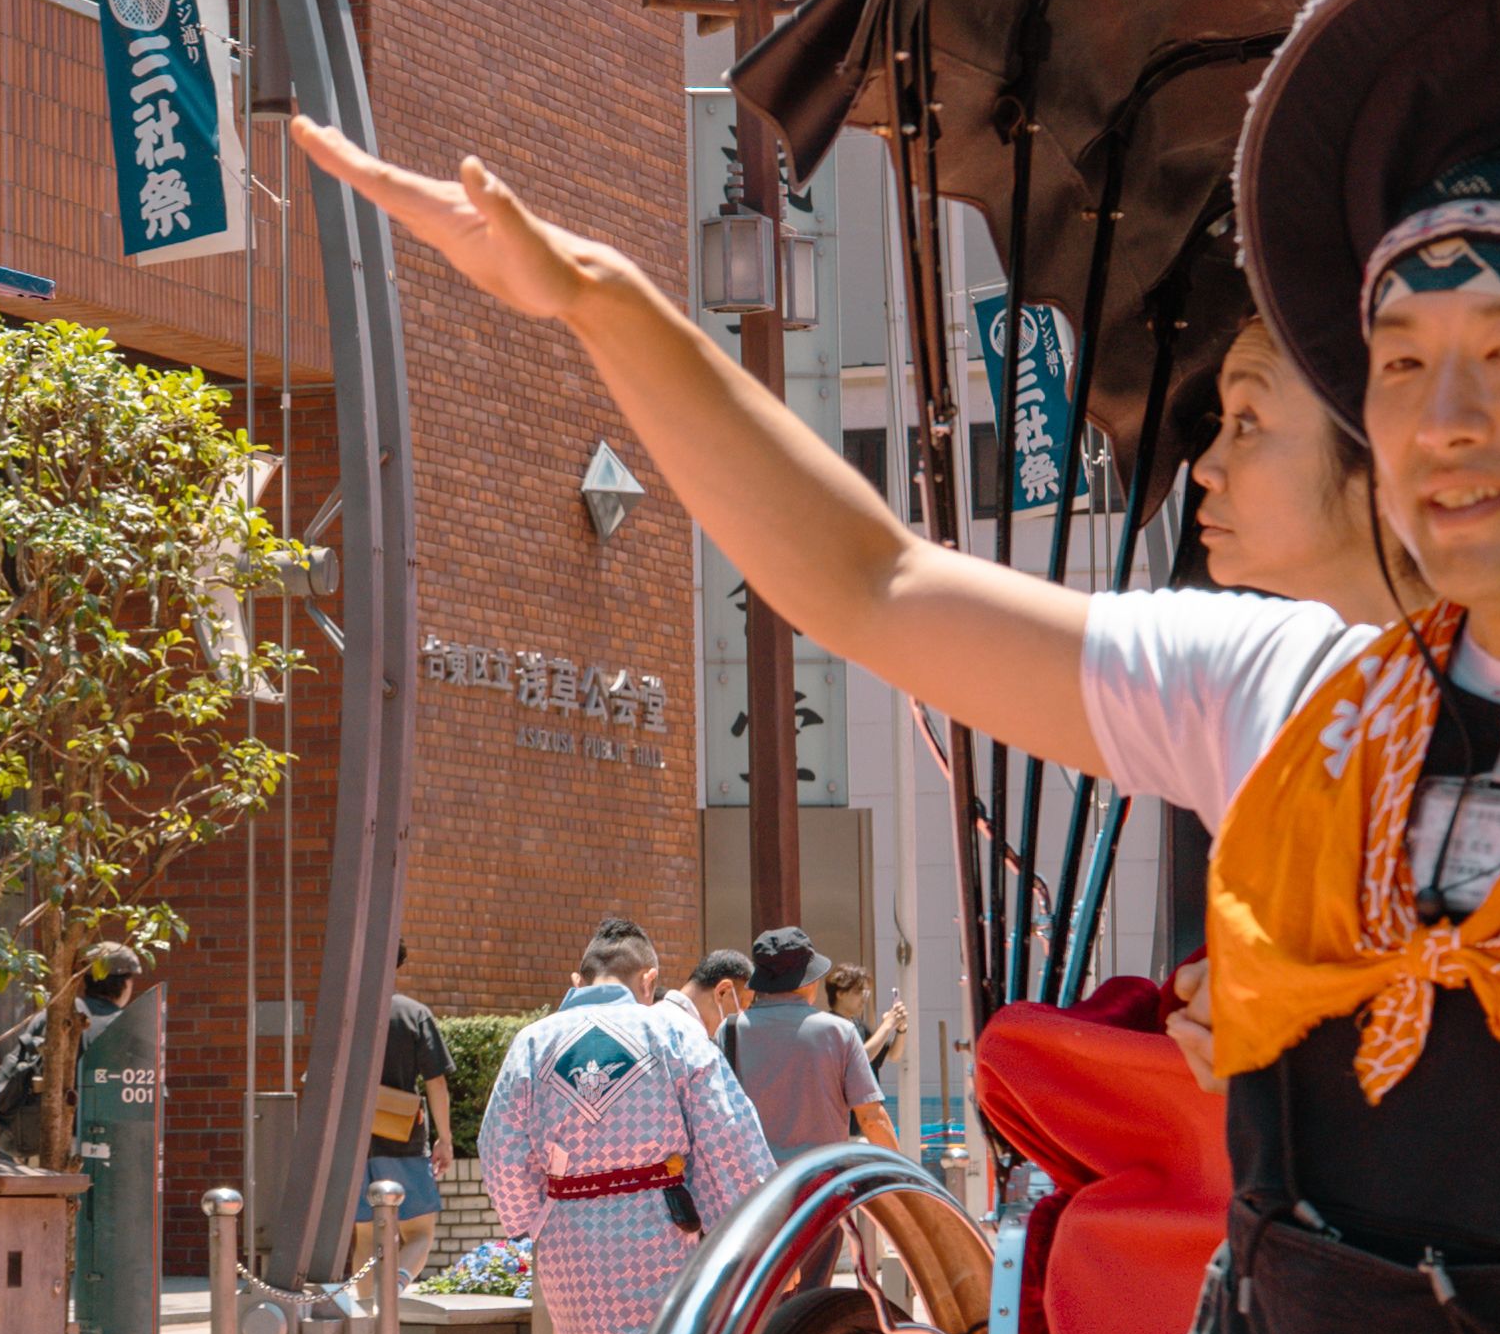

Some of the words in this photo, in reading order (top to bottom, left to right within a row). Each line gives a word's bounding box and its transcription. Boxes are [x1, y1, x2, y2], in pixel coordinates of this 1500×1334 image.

[127, 34, 192, 241] 三社祭
[1015, 357, 1060, 503] 三社祭
[422, 634, 668, 733] 台東区立浅草公会堂
[516, 725, 575, 756] ASAKUSA
[583, 735, 628, 764] PUBLIC
[635, 744, 666, 769] HALL
[121, 1087, 155, 1104] 001
